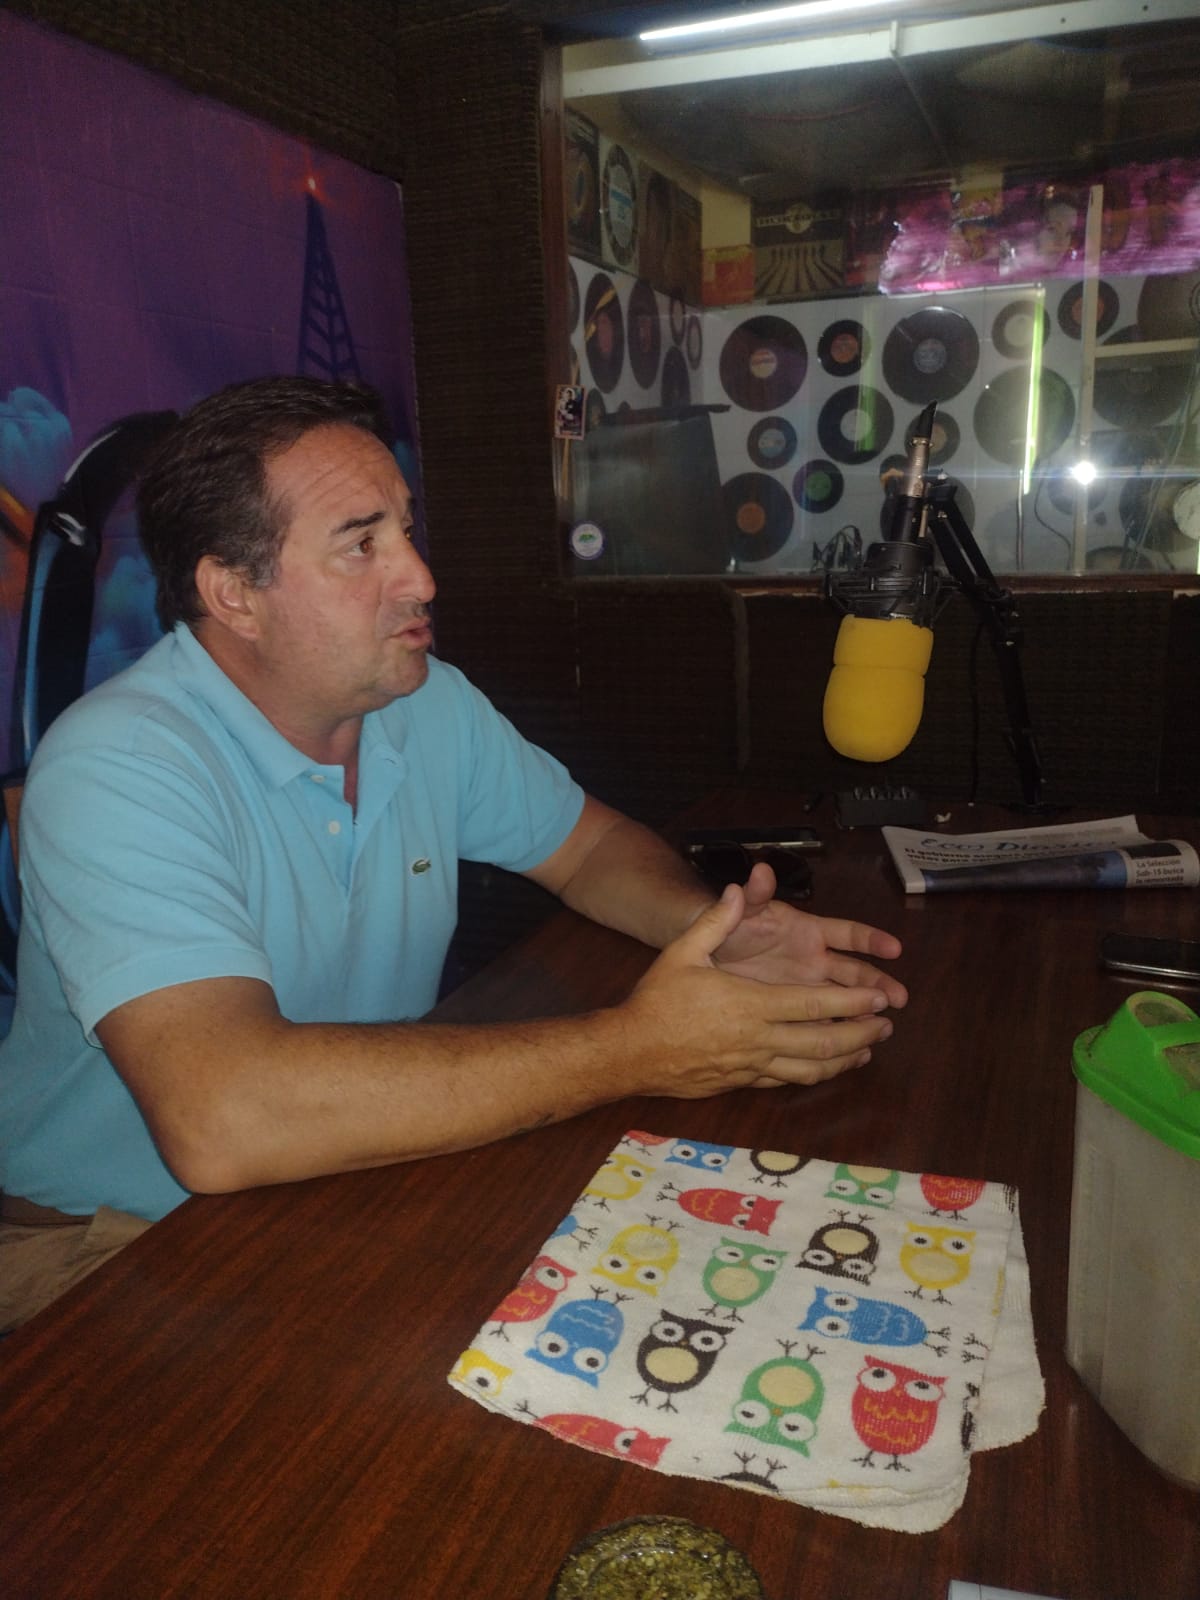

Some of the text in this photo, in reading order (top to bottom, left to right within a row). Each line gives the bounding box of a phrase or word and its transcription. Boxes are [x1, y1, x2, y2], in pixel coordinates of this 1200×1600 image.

[917, 850, 971, 858] gobierno
[1136, 867, 1185, 877] Sub-15 busca
